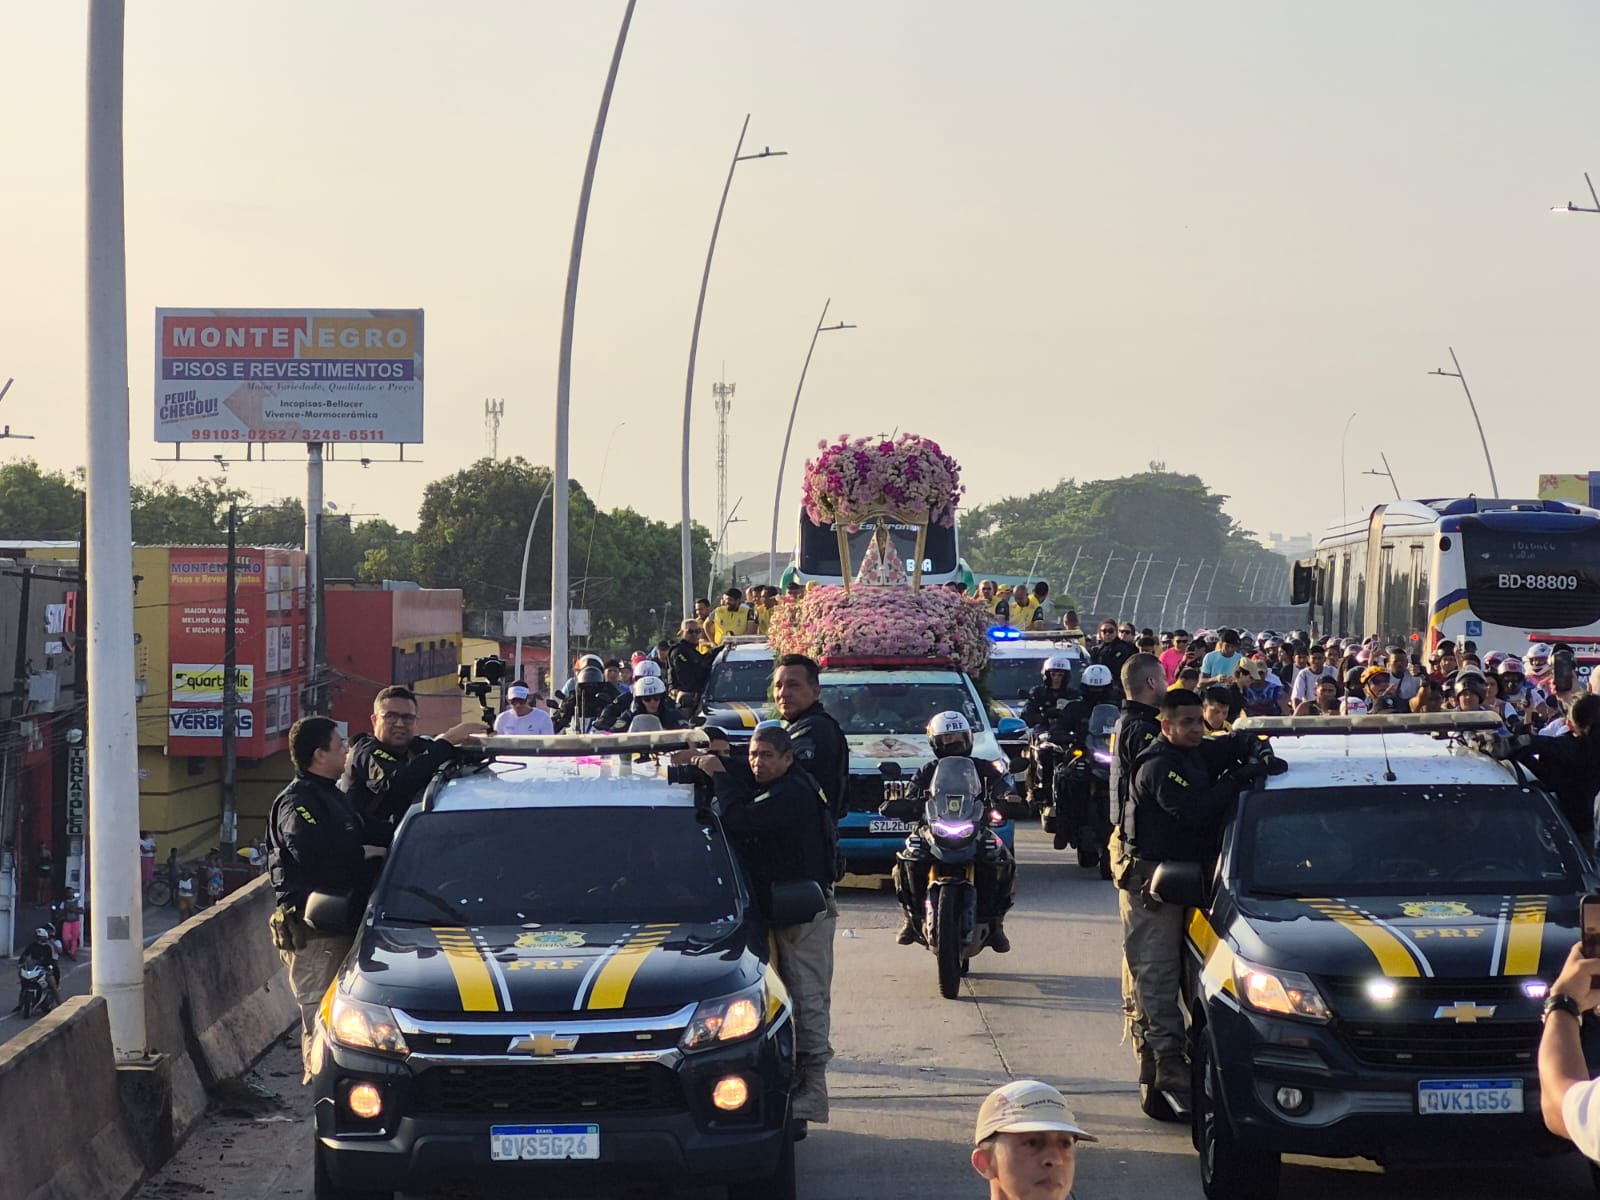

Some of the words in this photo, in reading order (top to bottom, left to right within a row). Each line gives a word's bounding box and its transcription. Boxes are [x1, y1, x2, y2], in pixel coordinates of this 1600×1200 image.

[172, 327, 408, 348] MONTENEGRO
[172, 362, 227, 378] PISOS
[233, 363, 244, 378] E
[250, 362, 404, 378] REVESTIMENTOS
[159, 398, 219, 420] CHEGOU!
[191, 429, 288, 440] 99103-0252
[301, 429, 385, 440] 3248-6511
[906, 558, 932, 572] BA
[1498, 574, 1578, 590] BD-88809
[945, 721, 964, 731] PRF
[1167, 770, 1190, 788] PRF
[1412, 927, 1485, 939] PRF
[506, 959, 584, 971] PRF
[1427, 1091, 1512, 1111] QVK1G56
[502, 1136, 588, 1157] QVS5G26
